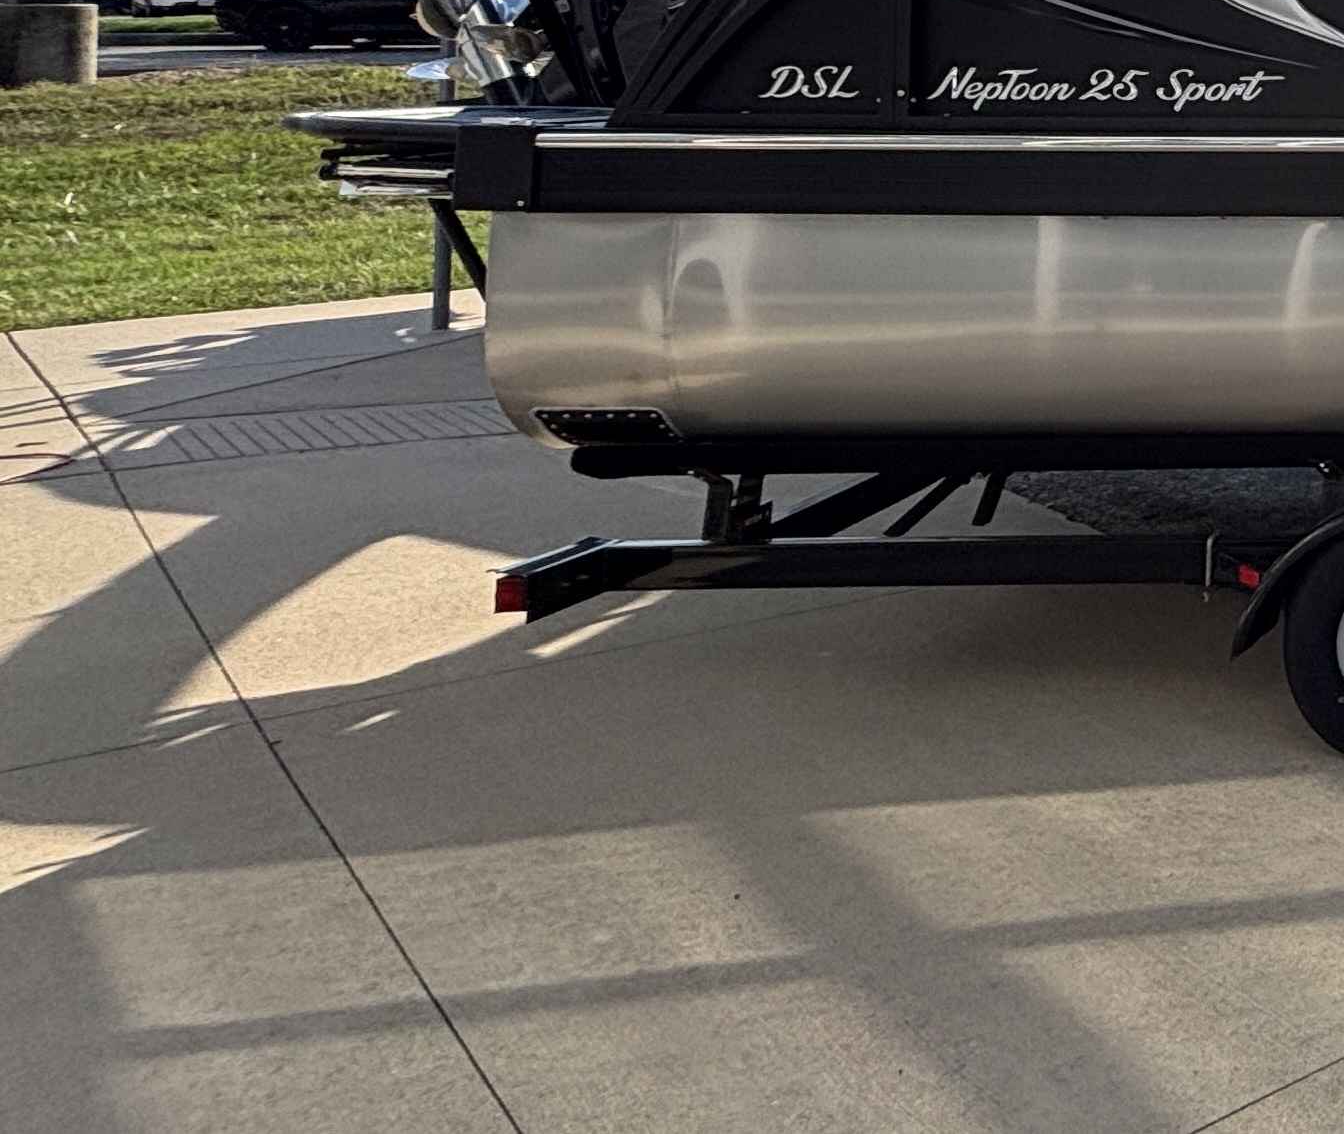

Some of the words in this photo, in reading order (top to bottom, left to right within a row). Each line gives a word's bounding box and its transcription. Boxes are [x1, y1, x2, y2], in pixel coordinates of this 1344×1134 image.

[758, 65, 860, 99] DSL
[926, 66, 1077, 111] NepToon
[1078, 68, 1146, 102] 25
[1155, 69, 1286, 113] Sport
